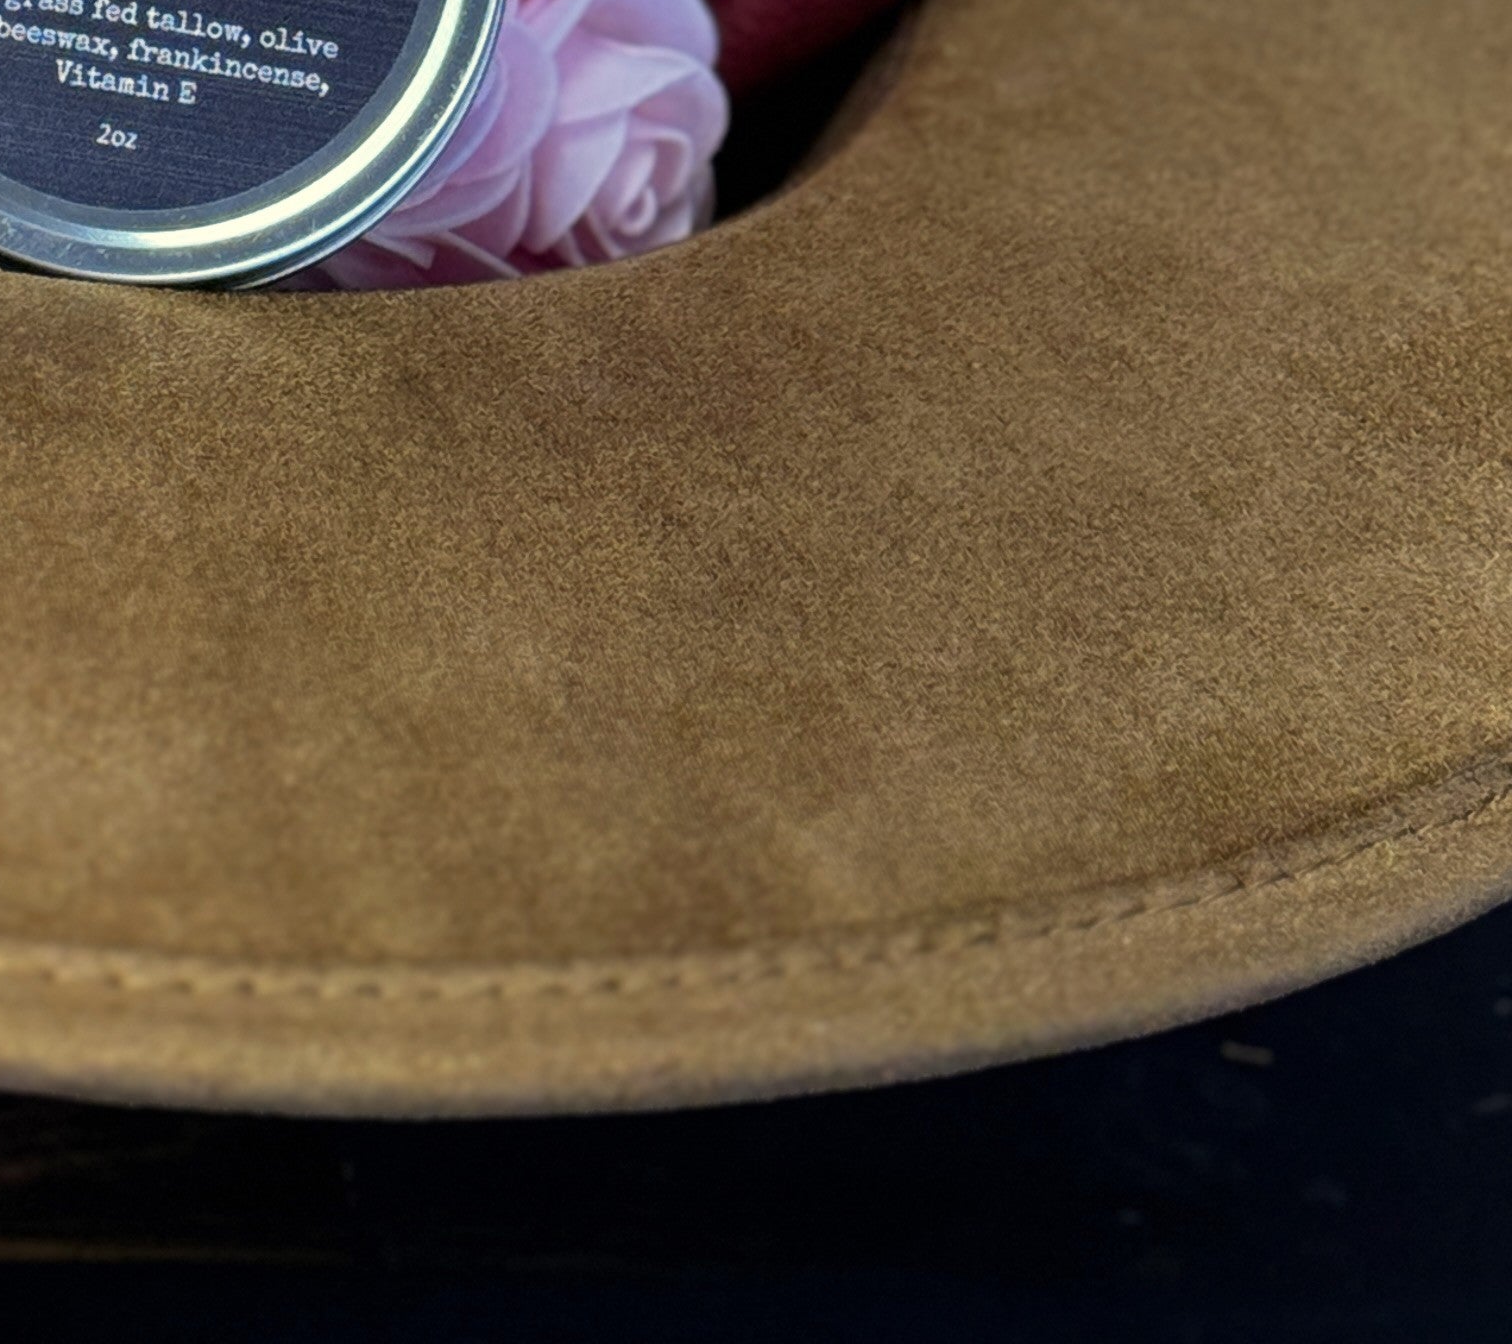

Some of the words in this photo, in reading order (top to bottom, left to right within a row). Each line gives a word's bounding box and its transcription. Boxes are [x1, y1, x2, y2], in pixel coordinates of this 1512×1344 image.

[147, 7, 251, 49] tallow,
[259, 26, 340, 60] olive
[56, 59, 170, 103] Vitamin
[179, 81, 198, 105] E
[126, 37, 330, 99] frankincense,
[95, 122, 138, 151] 2oz
